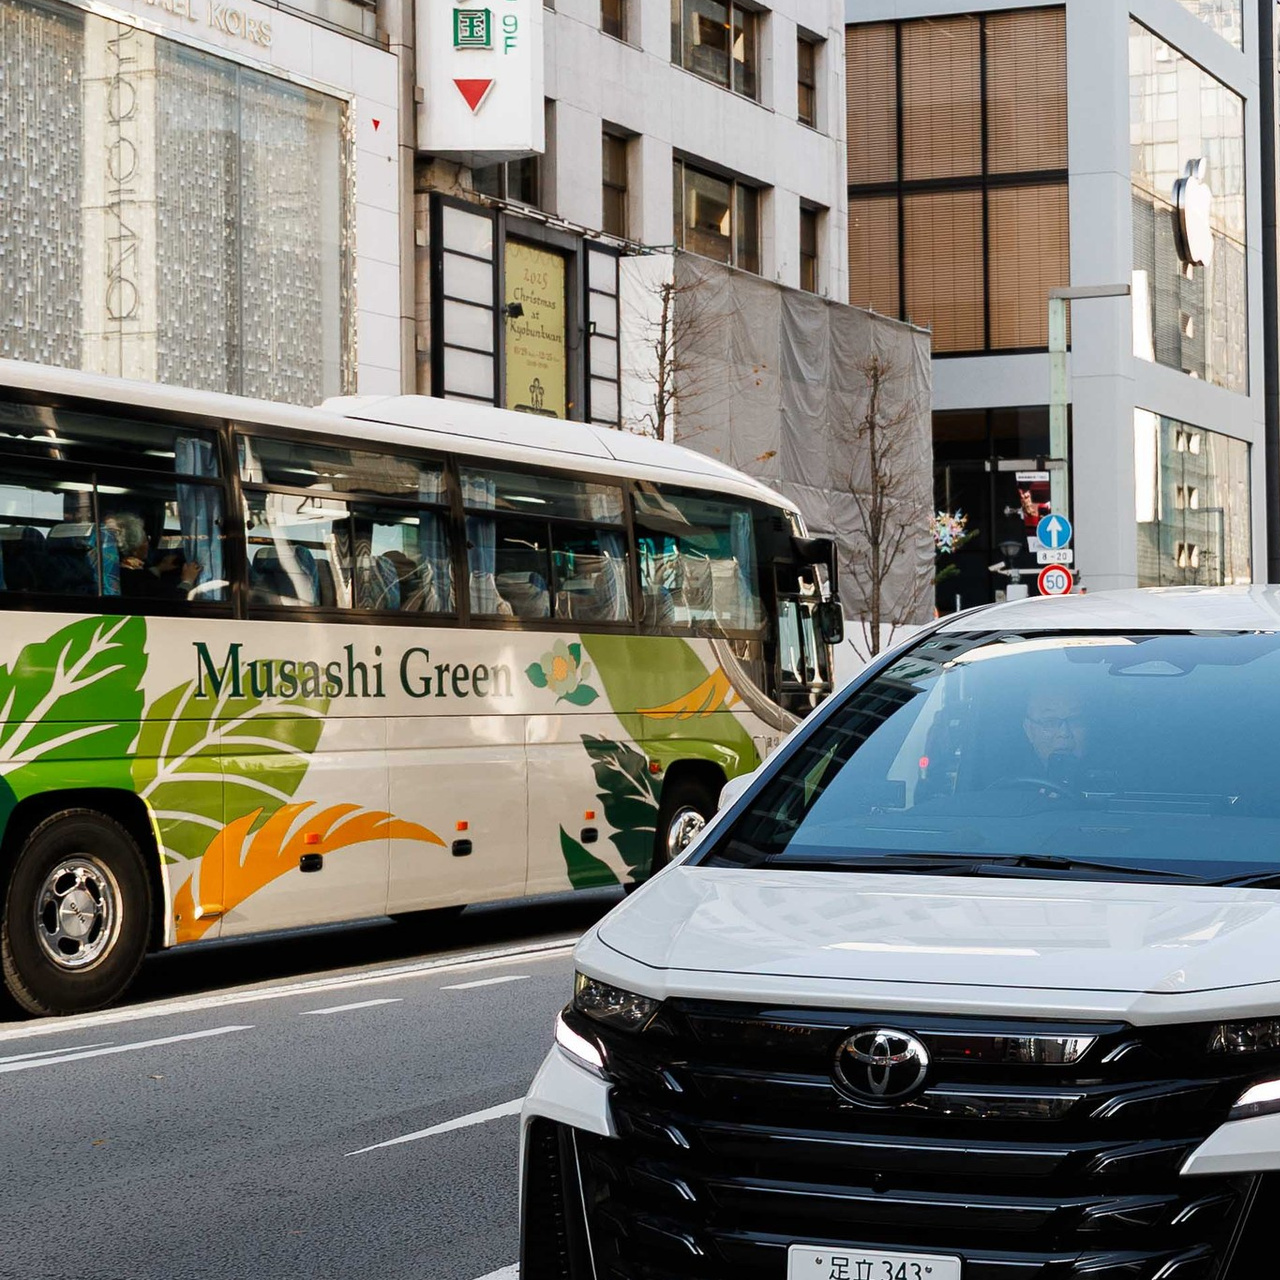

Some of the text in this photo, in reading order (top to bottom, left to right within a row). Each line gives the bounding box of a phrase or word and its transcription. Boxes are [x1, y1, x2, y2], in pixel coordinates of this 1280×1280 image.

[207, 0, 273, 47] KORS
[502, 15, 517, 55] 9F
[513, 287, 556, 310] Christmas
[531, 311, 540, 320] at
[510, 320, 562, 343] Kyobunkwan
[1046, 574, 1065, 590] 50
[192, 641, 514, 701] Musashi Green
